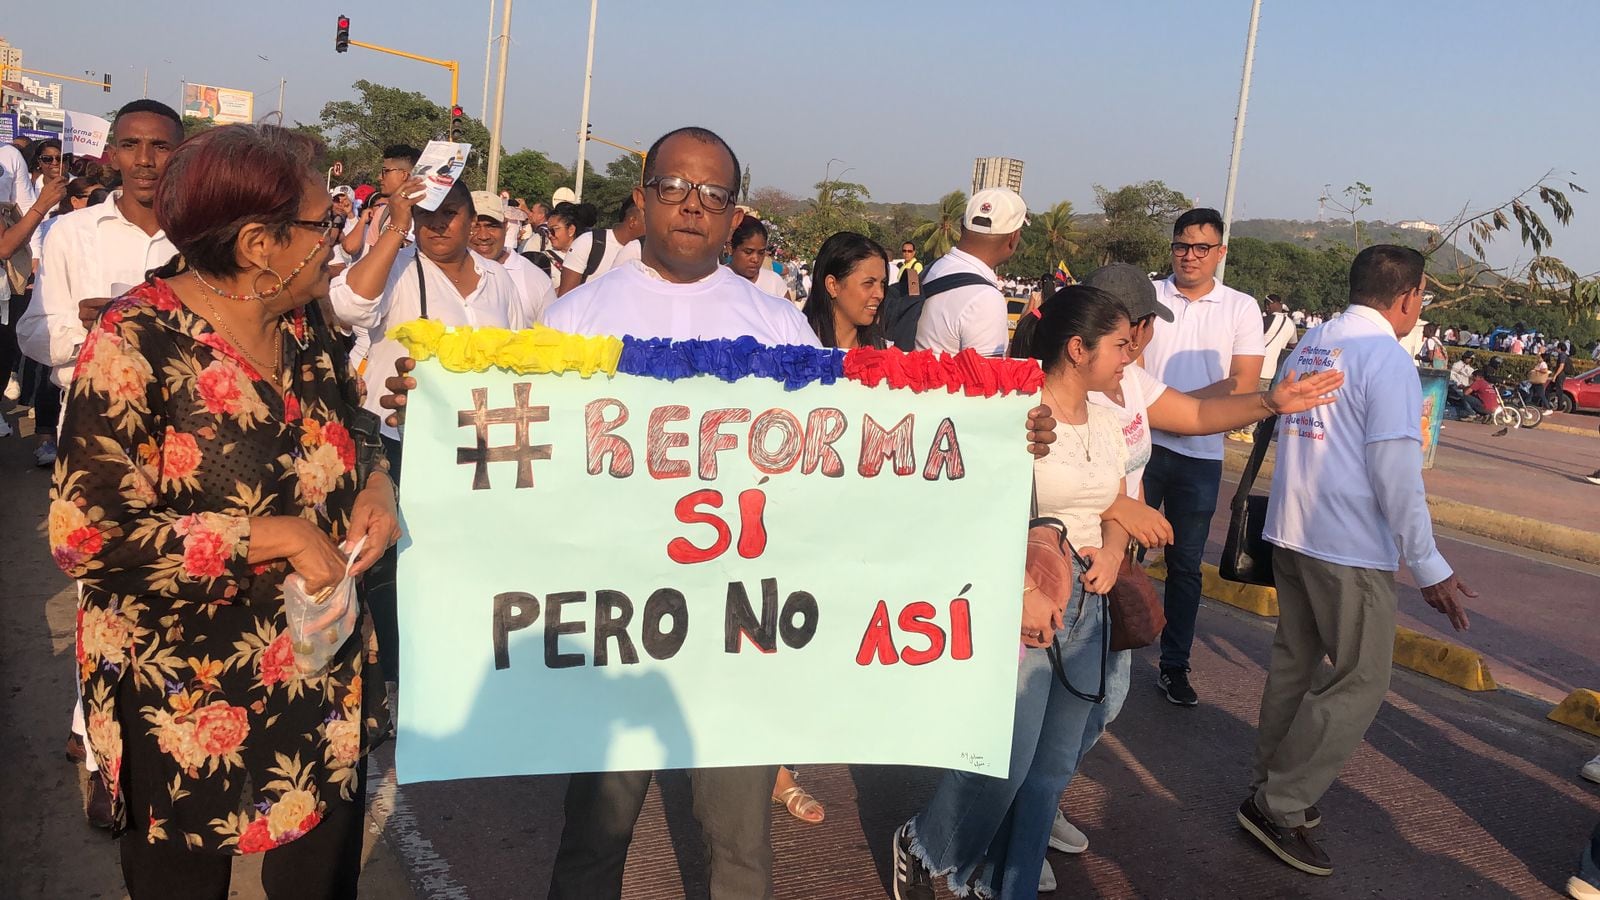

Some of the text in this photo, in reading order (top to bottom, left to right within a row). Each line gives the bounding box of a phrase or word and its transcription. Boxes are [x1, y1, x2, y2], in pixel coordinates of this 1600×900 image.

[667, 476, 768, 565] SÍ
[493, 577, 974, 671] PERO NO ASÍ
